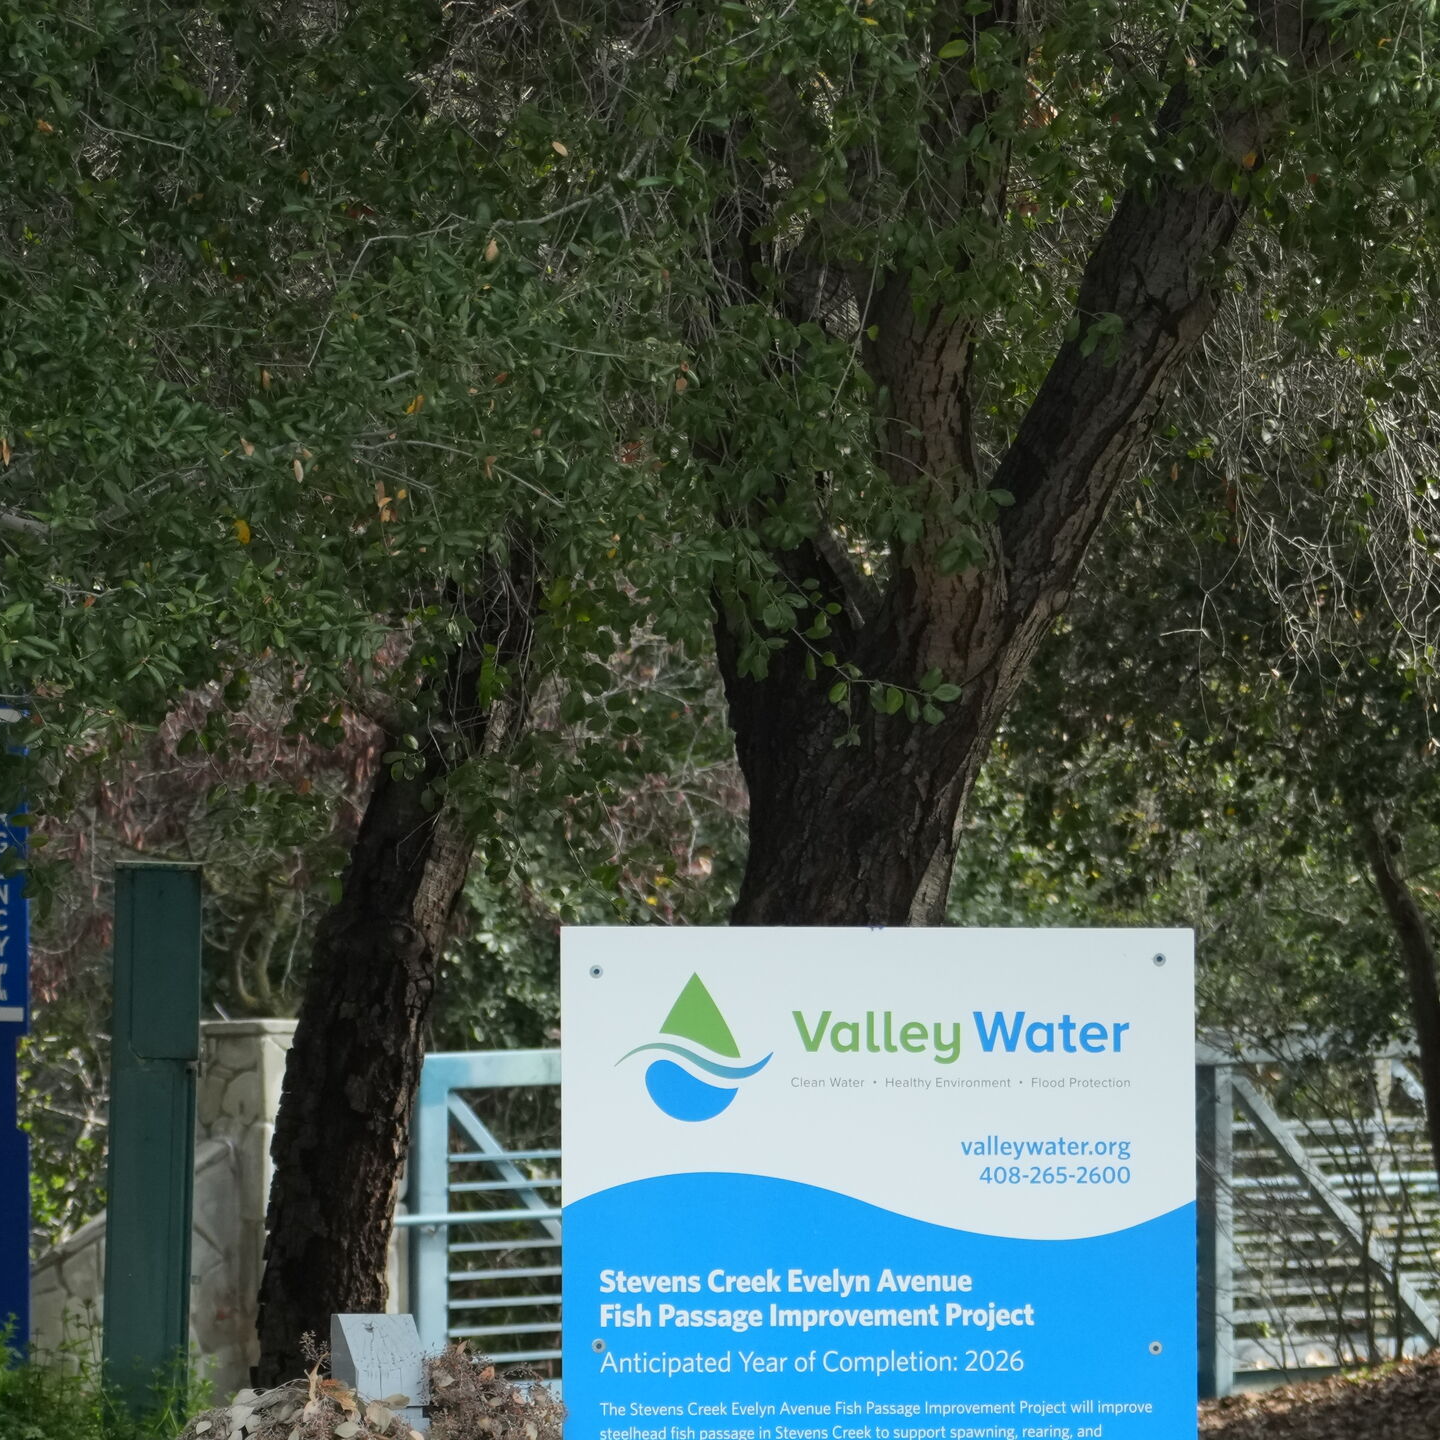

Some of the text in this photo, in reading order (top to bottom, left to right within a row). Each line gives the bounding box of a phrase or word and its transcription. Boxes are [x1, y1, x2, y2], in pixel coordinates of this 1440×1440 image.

[791, 1011, 1129, 1064] Valley Water
[790, 1077, 1130, 1090] Clean Water Healthy Environment Flood Protection
[960, 1136, 1131, 1160] valleywater.org
[978, 1166, 1130, 1184] 408-265-2600
[599, 1268, 972, 1297] Stevens Creek Evelyn Avenue
[599, 1302, 1034, 1332] Fish Passage Improvement Project
[599, 1350, 1024, 1377] Anticipated Year of Completion: 2026
[599, 1400, 1152, 1418] The Stevens Creek Evelyn Avenue Fish Passage Improvement Project will improve
